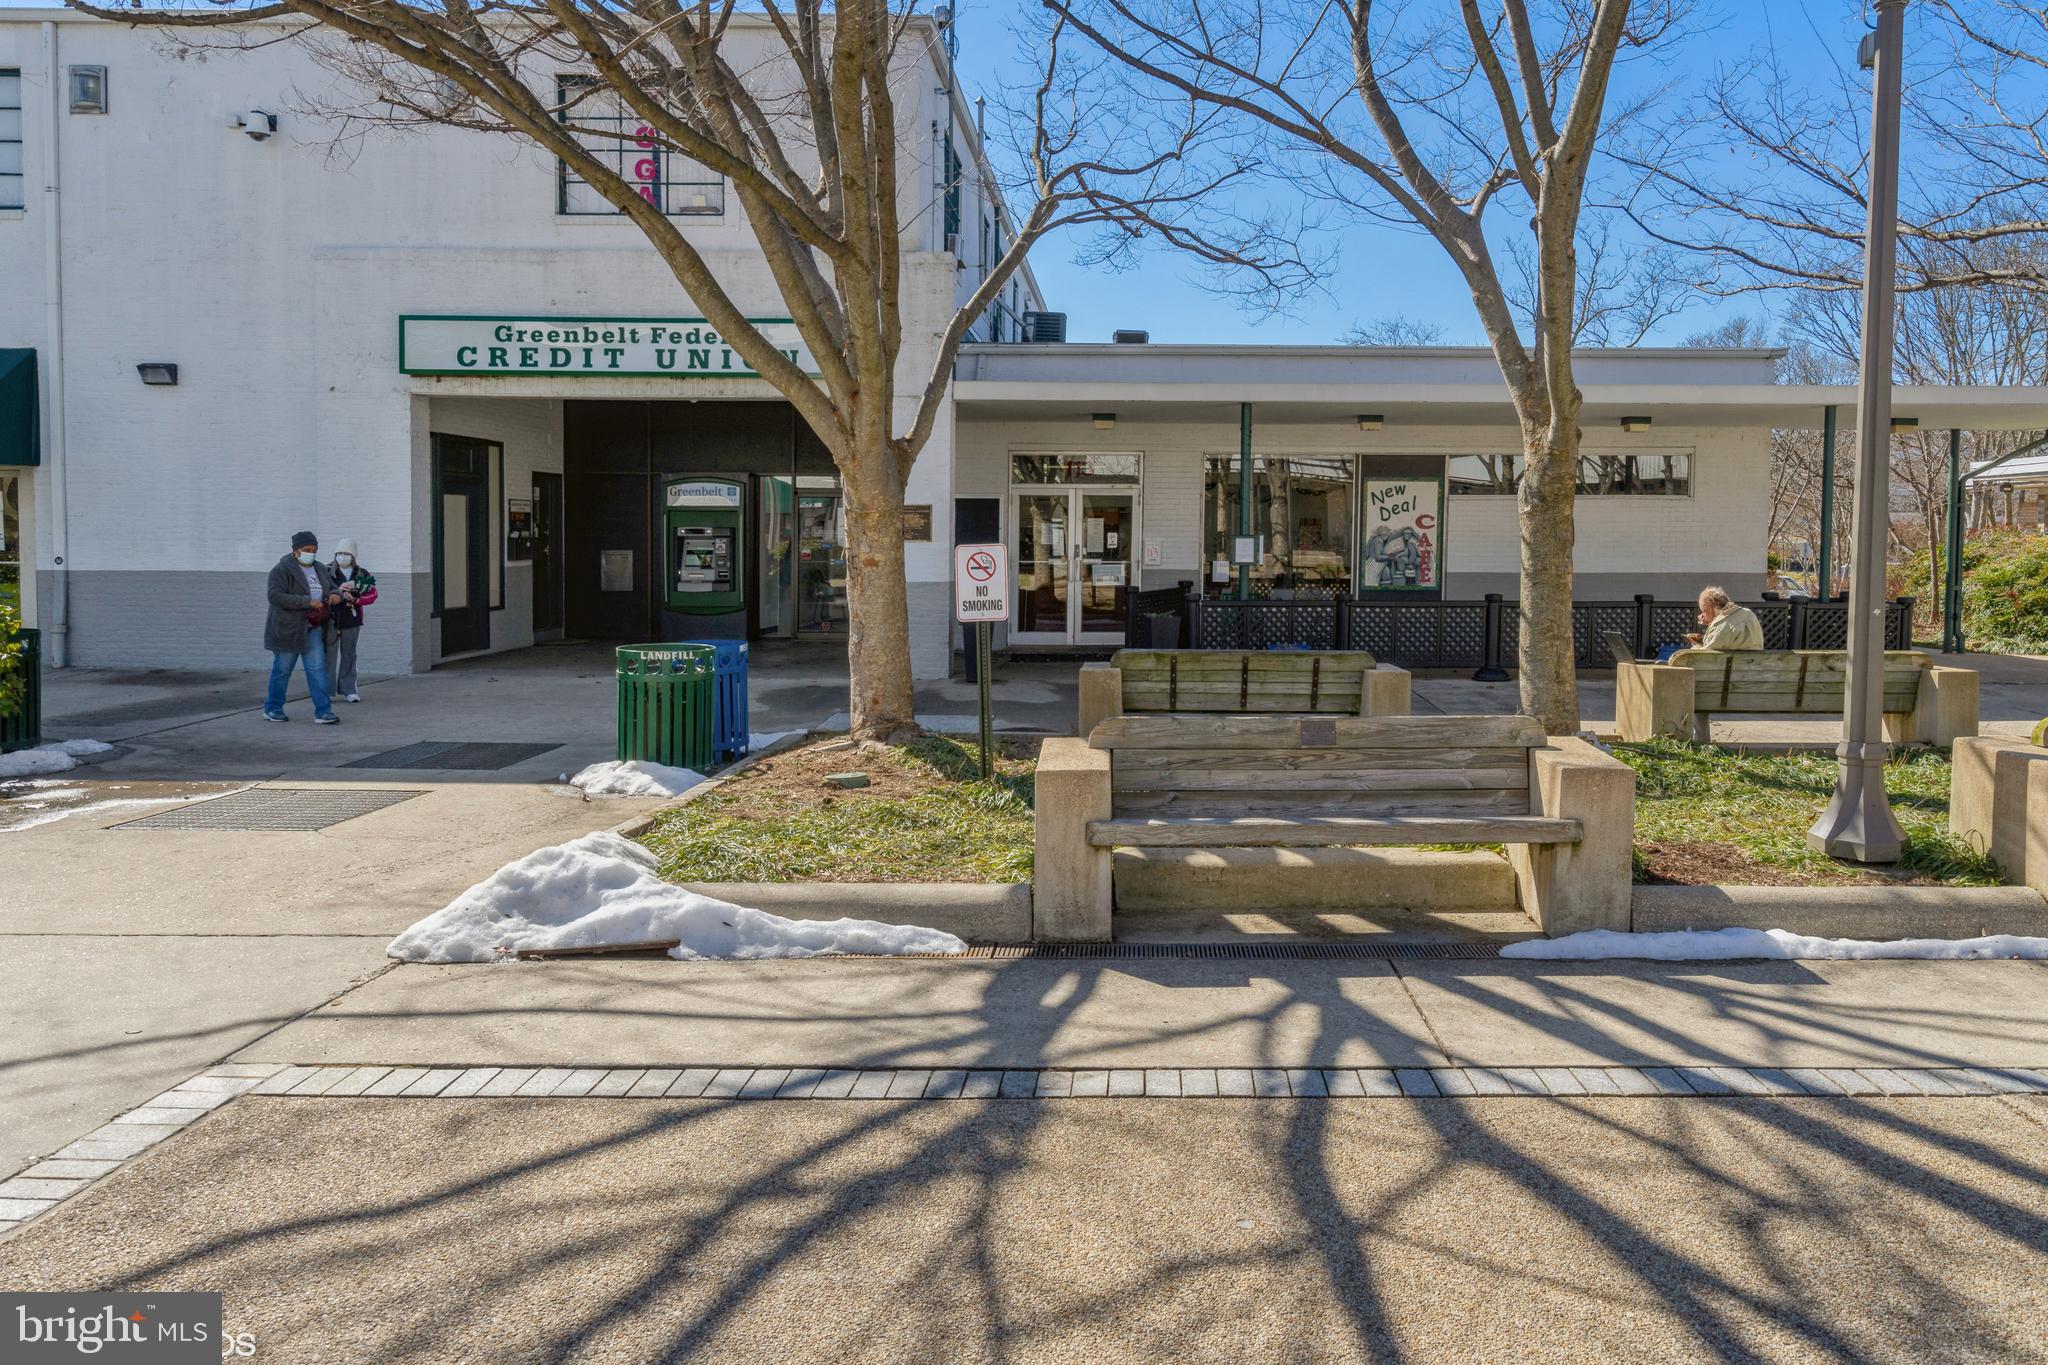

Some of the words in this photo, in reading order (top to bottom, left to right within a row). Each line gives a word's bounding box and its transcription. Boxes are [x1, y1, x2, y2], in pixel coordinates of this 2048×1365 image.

[495, 324, 640, 345] Greenbelt
[650, 327, 728, 345] Fede
[456, 346, 625, 369] CREDIT
[669, 486, 723, 497] Greenbelt
[1371, 485, 1406, 506] New
[1380, 495, 1417, 521] Deal
[976, 586, 988, 597] NO
[962, 600, 1003, 612] SMOKING
[640, 650, 695, 660] LANDFILL
